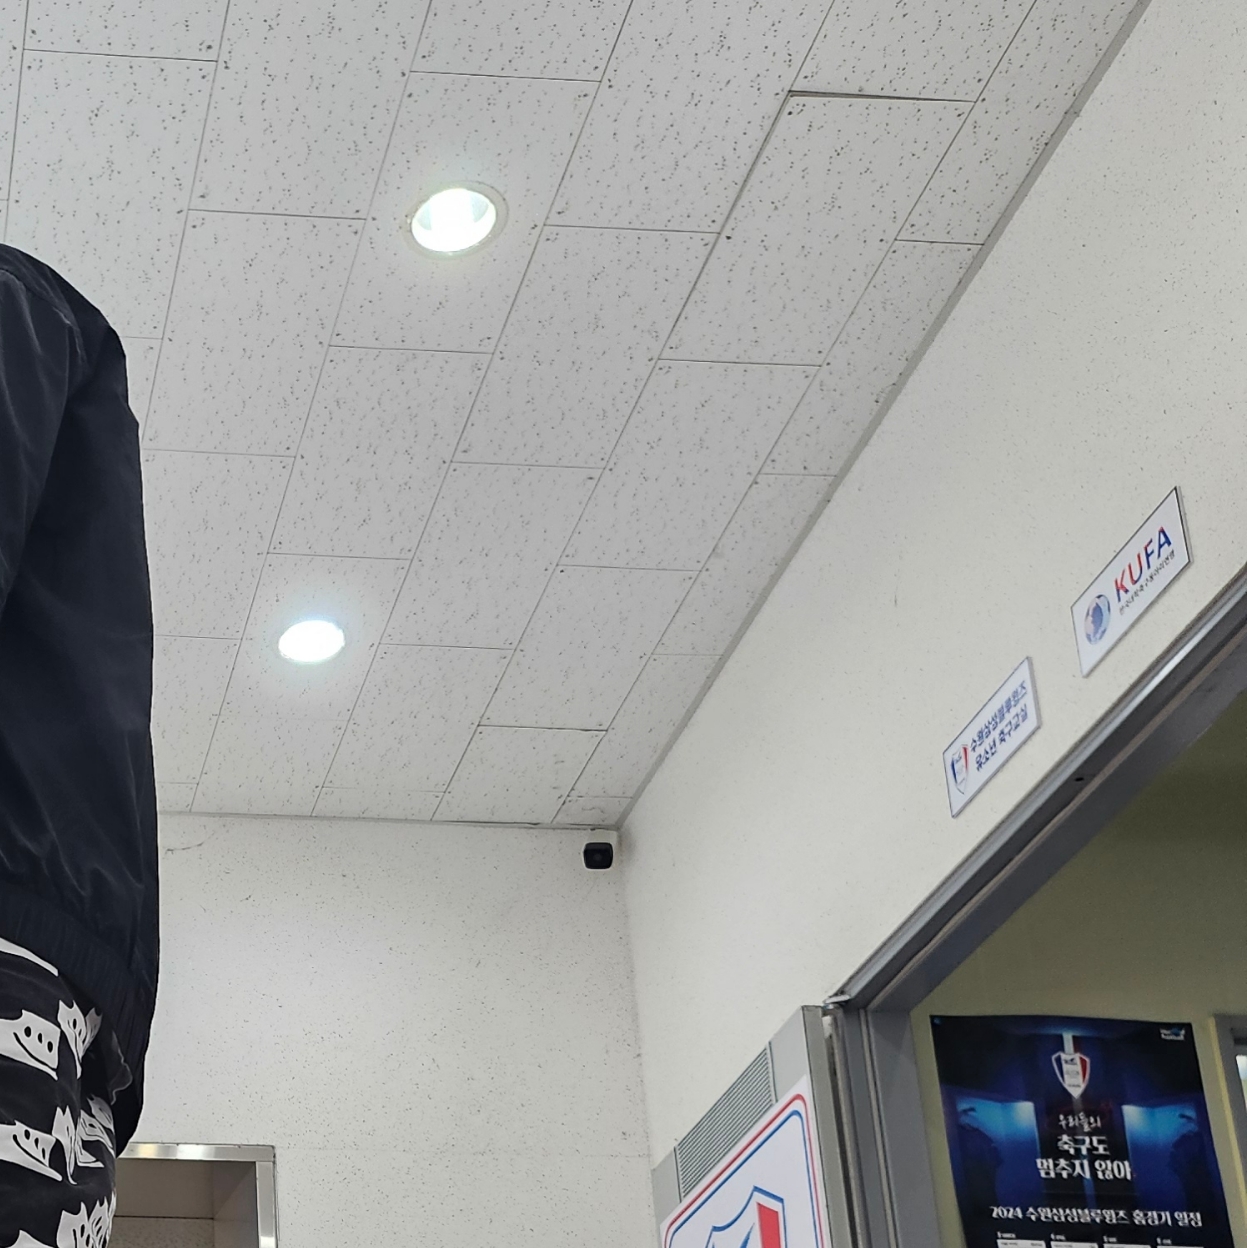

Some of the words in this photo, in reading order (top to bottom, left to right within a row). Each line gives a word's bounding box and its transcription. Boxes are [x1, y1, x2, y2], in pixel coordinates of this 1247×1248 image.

[1114, 526, 1172, 602] KUFA
[975, 737, 998, 772] 유소년
[998, 703, 1029, 745] 축구교실
[1058, 1112, 1102, 1132] 우리들의
[1057, 1133, 1111, 1156] 축구도
[1035, 1158, 1092, 1179] 멈추지
[1094, 1159, 1132, 1181] 않아
[989, 1206, 1023, 1220] 2024
[1174, 1211, 1203, 1228] 일정
